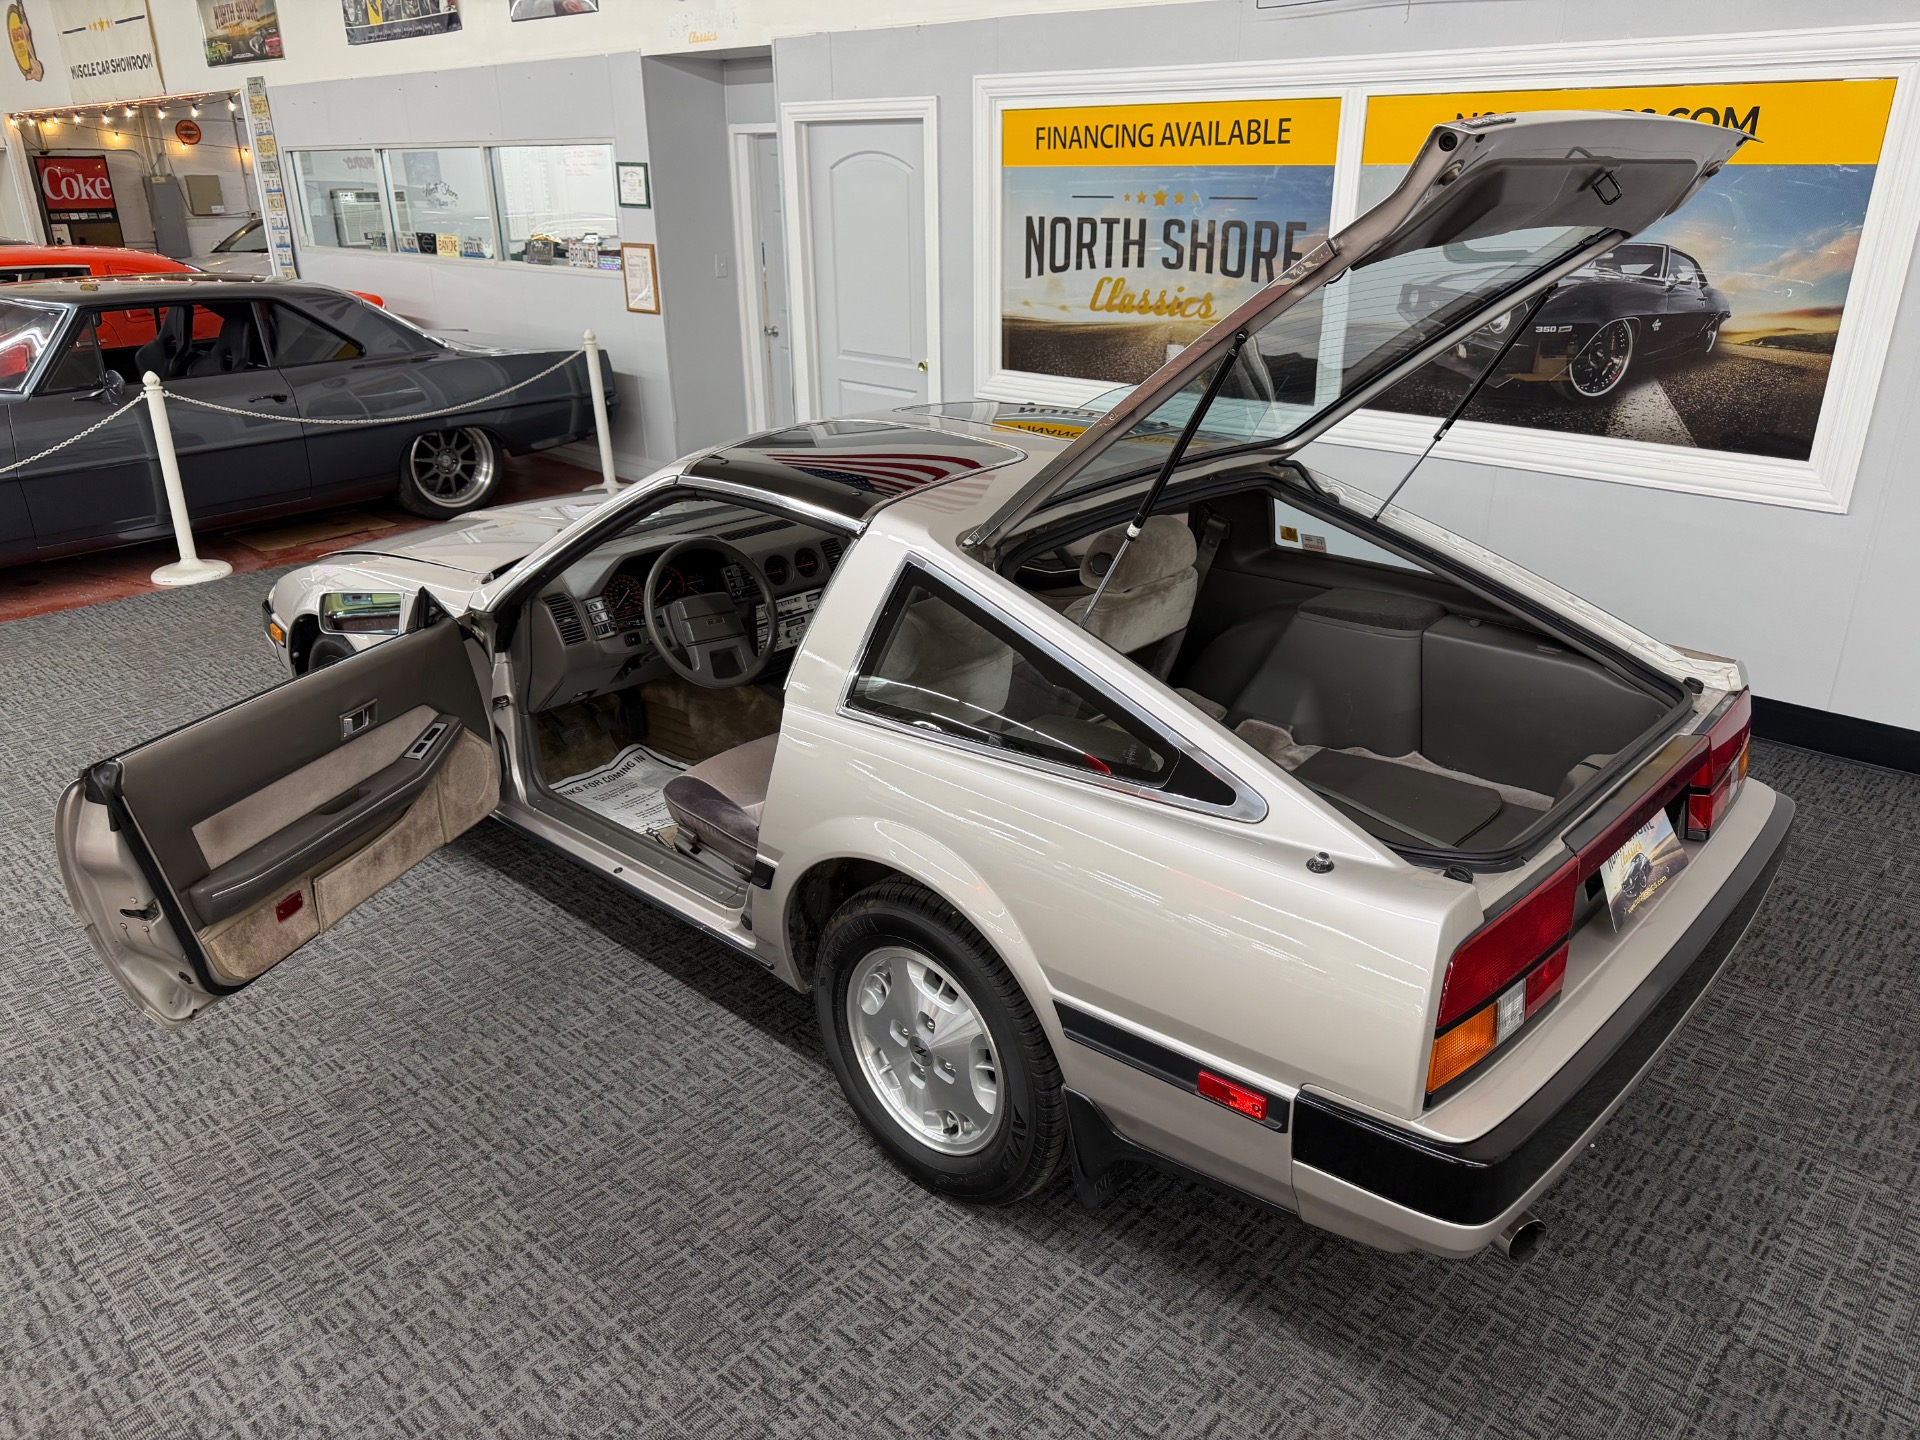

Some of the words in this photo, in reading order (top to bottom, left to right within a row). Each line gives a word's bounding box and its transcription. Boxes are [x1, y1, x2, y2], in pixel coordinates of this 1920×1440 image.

[70, 62, 96, 80] MUSCLE
[96, 60, 111, 75] CAR
[111, 53, 153, 73] SHOWROOM
[1035, 122, 1154, 150] FINANCING
[1160, 118, 1292, 147] AVAILABLE
[42, 166, 113, 200] Coke
[570, 247, 597, 264] BRONCO
[1025, 215, 1147, 279] NORTH
[1161, 218, 1308, 284] SHORE
[1089, 276, 1218, 319] Classics
[1535, 325, 1557, 333] 350
[584, 778, 604, 790] FOR
[601, 760, 637, 783] COMING
[633, 754, 647, 765] IN
